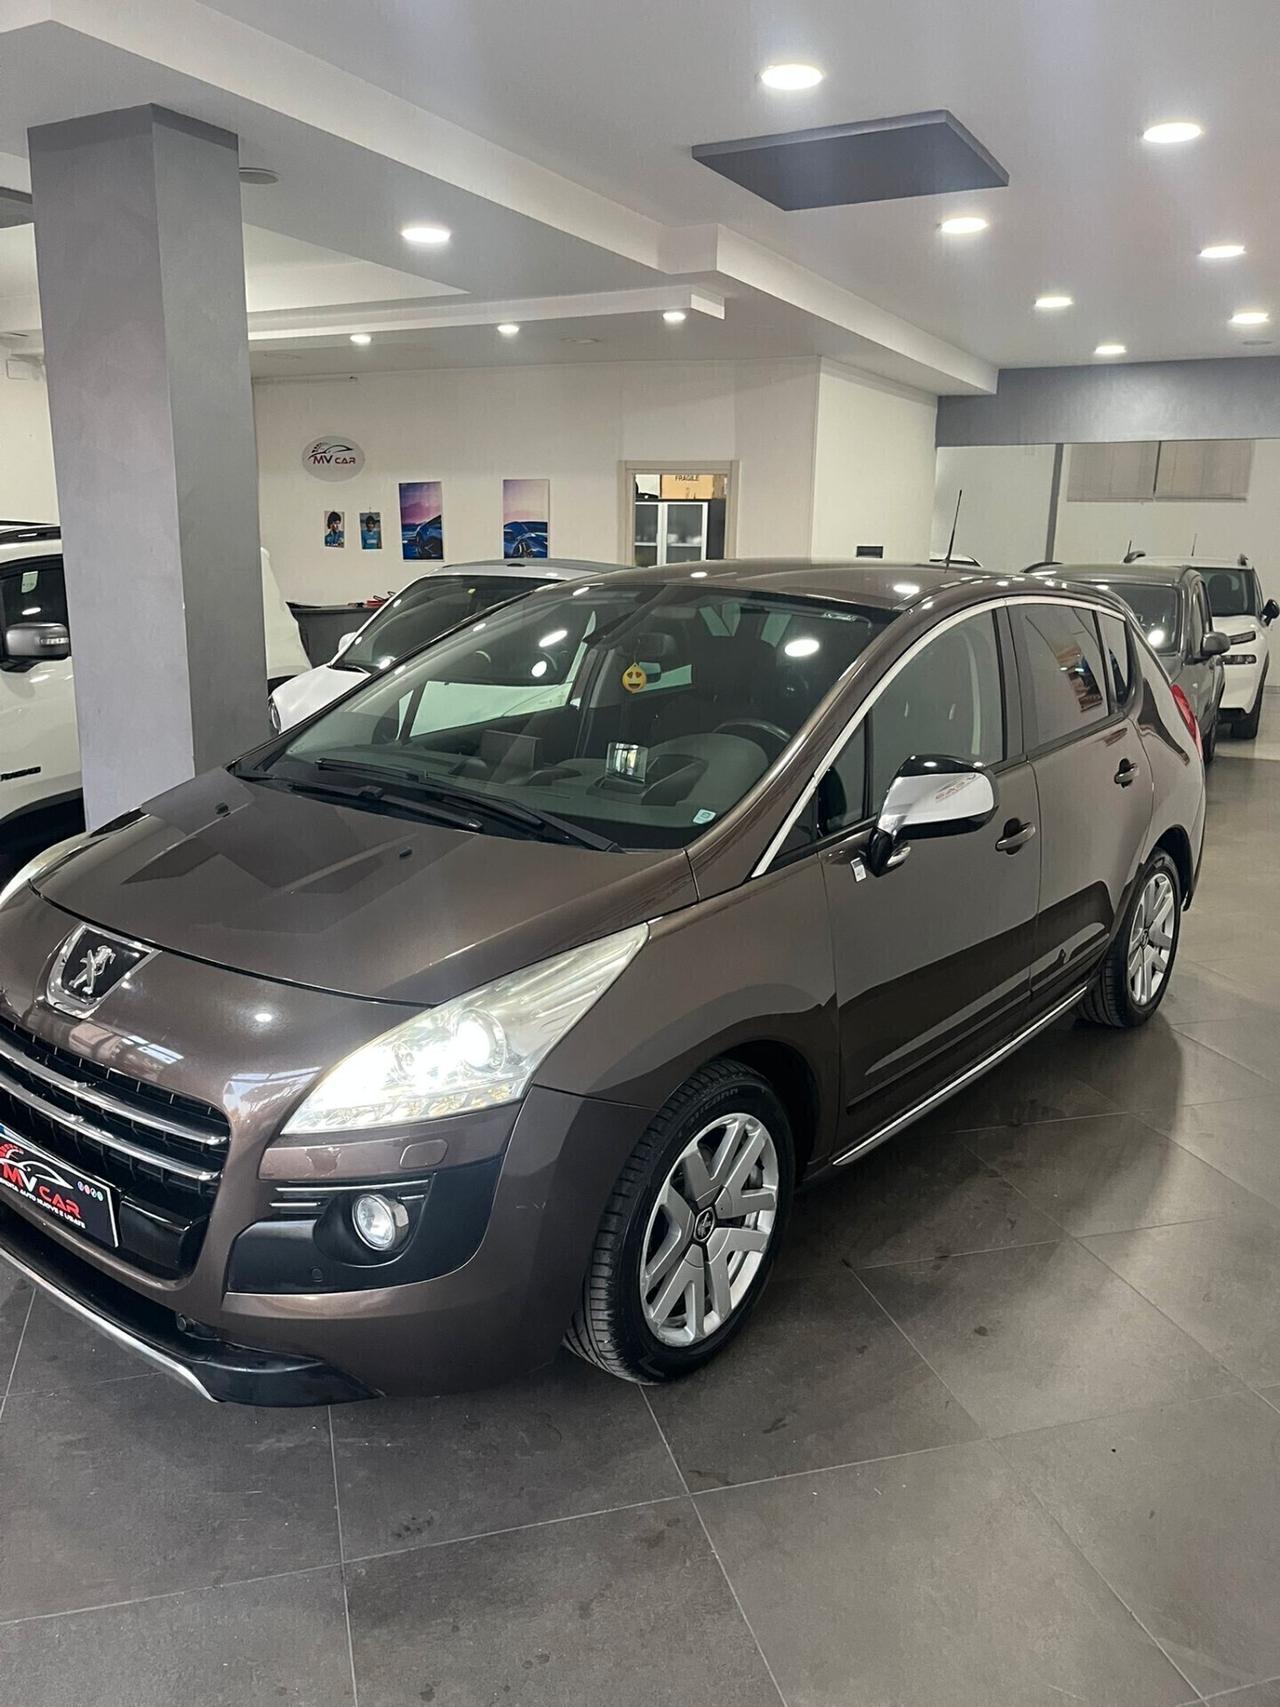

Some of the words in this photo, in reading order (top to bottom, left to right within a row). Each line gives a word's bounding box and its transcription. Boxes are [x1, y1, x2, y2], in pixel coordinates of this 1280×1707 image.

[313, 455, 333, 464] MV
[3, 1162, 38, 1192] MV
[39, 1186, 81, 1218] CAR
